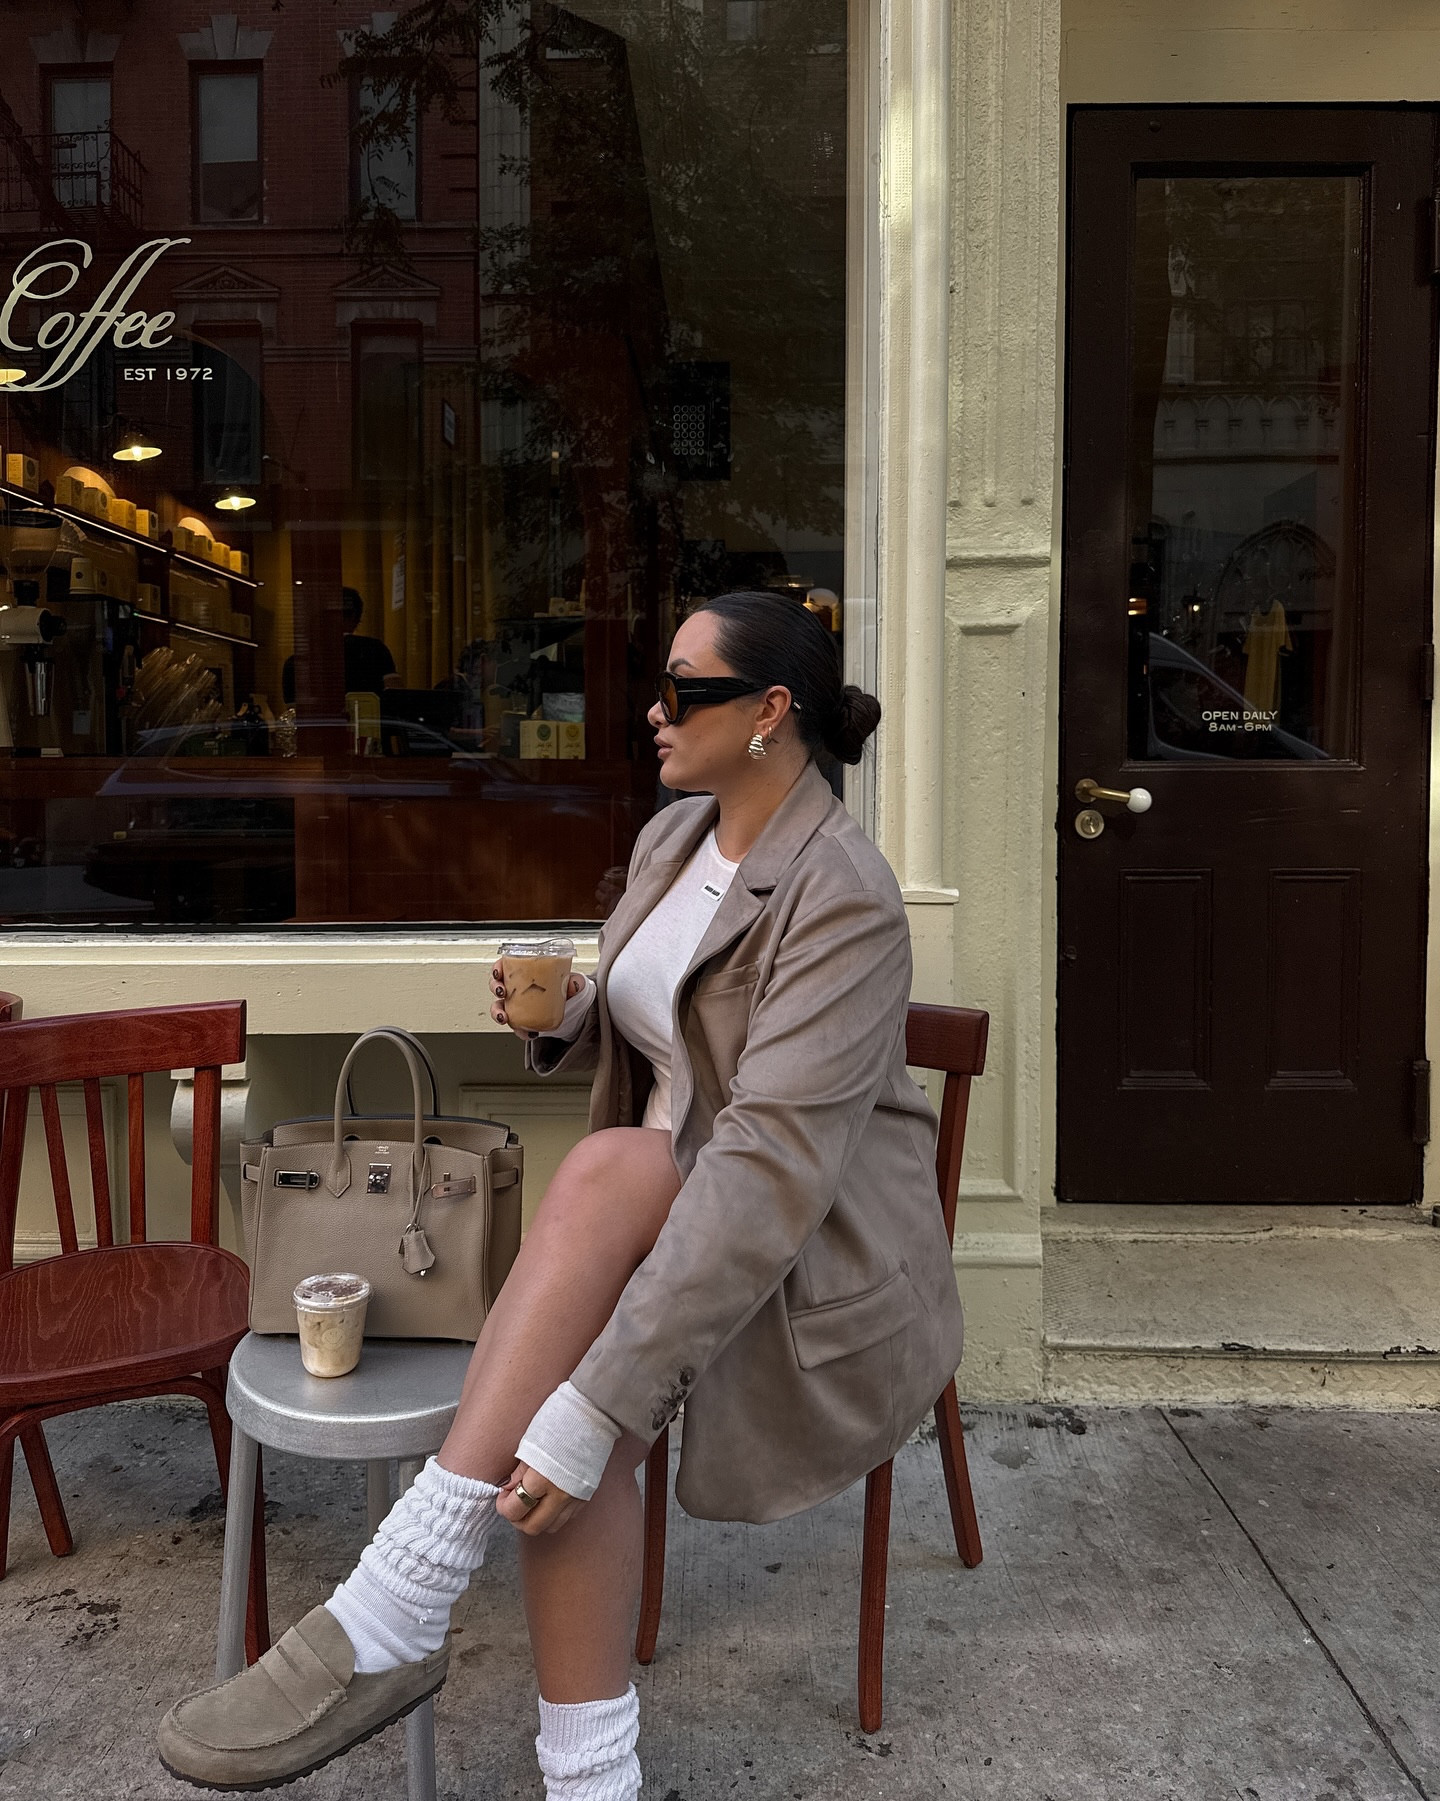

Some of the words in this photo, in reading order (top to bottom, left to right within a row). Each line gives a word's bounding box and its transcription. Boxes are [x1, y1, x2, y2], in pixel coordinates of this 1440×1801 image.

[0, 238, 192, 392] Coffee
[124, 368, 156, 381] EST
[166, 367, 213, 381] 1972
[1201, 710, 1239, 721] OPEN
[1242, 710, 1278, 720] DAILY
